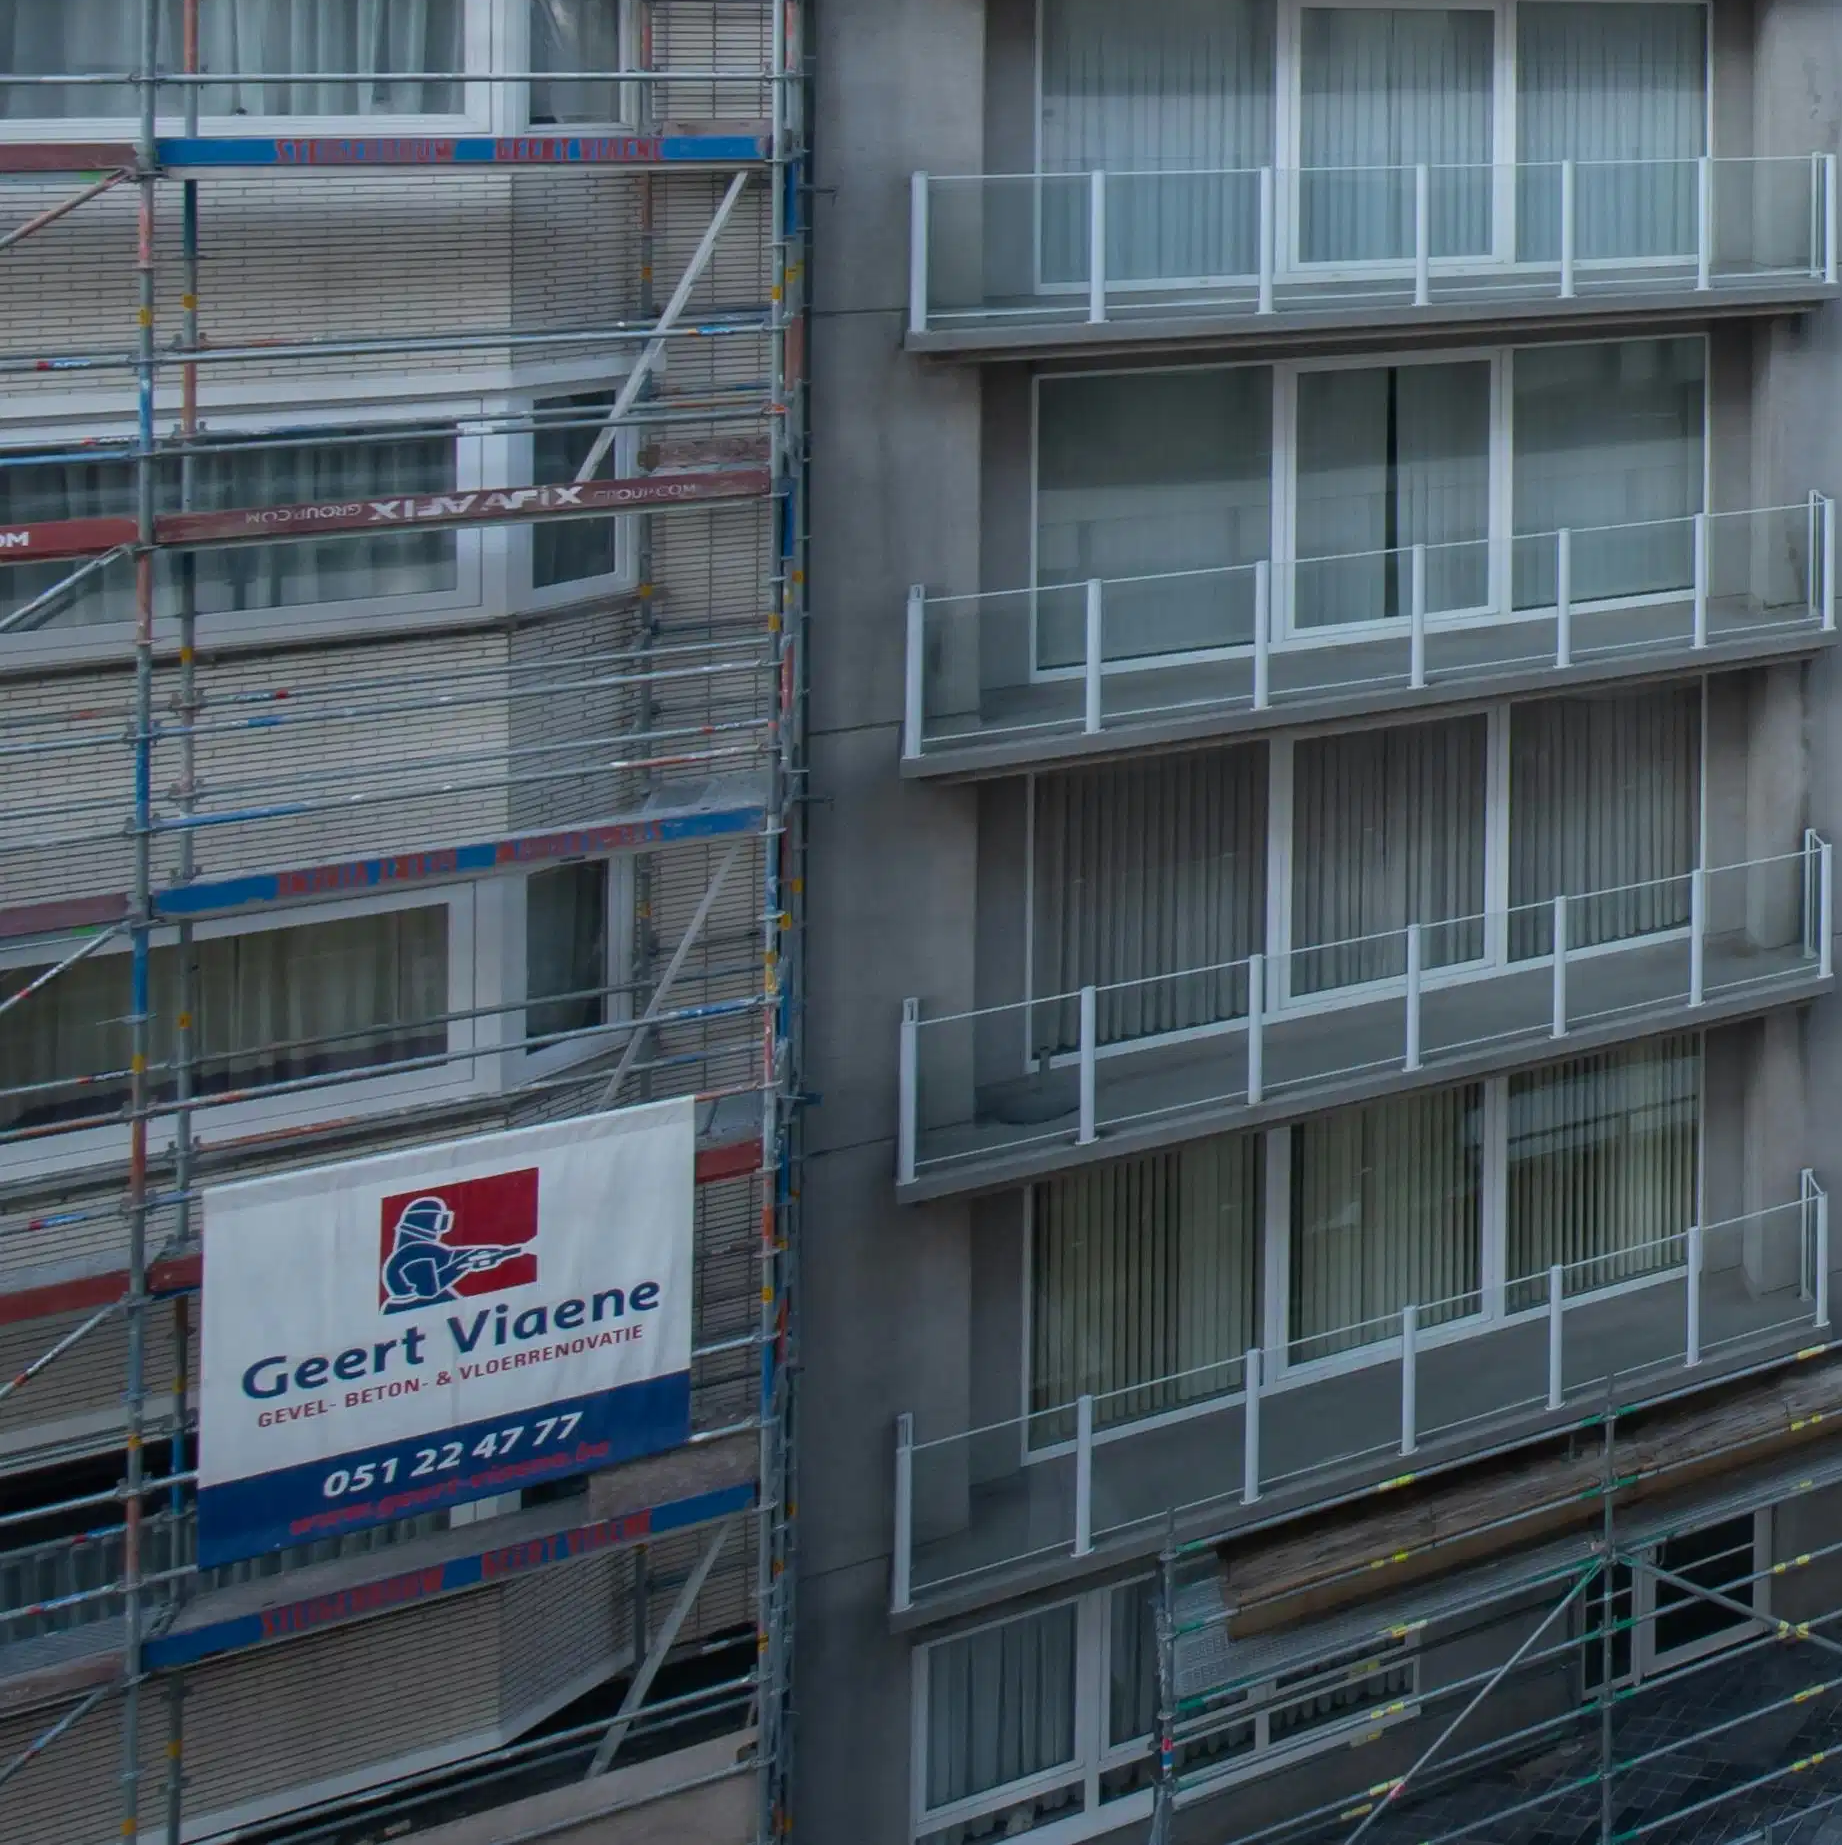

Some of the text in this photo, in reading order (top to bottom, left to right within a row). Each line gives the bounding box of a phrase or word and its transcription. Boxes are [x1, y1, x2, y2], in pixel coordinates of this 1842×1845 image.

[368, 494, 477, 521] AFIX
[479, 486, 583, 511] AFIX
[242, 1280, 660, 1399] Geert Viaene
[258, 1324, 643, 1428] GEVEL- BETON- & VLOERRENOVATIE
[323, 1411, 584, 1498] 051 22 47 77
